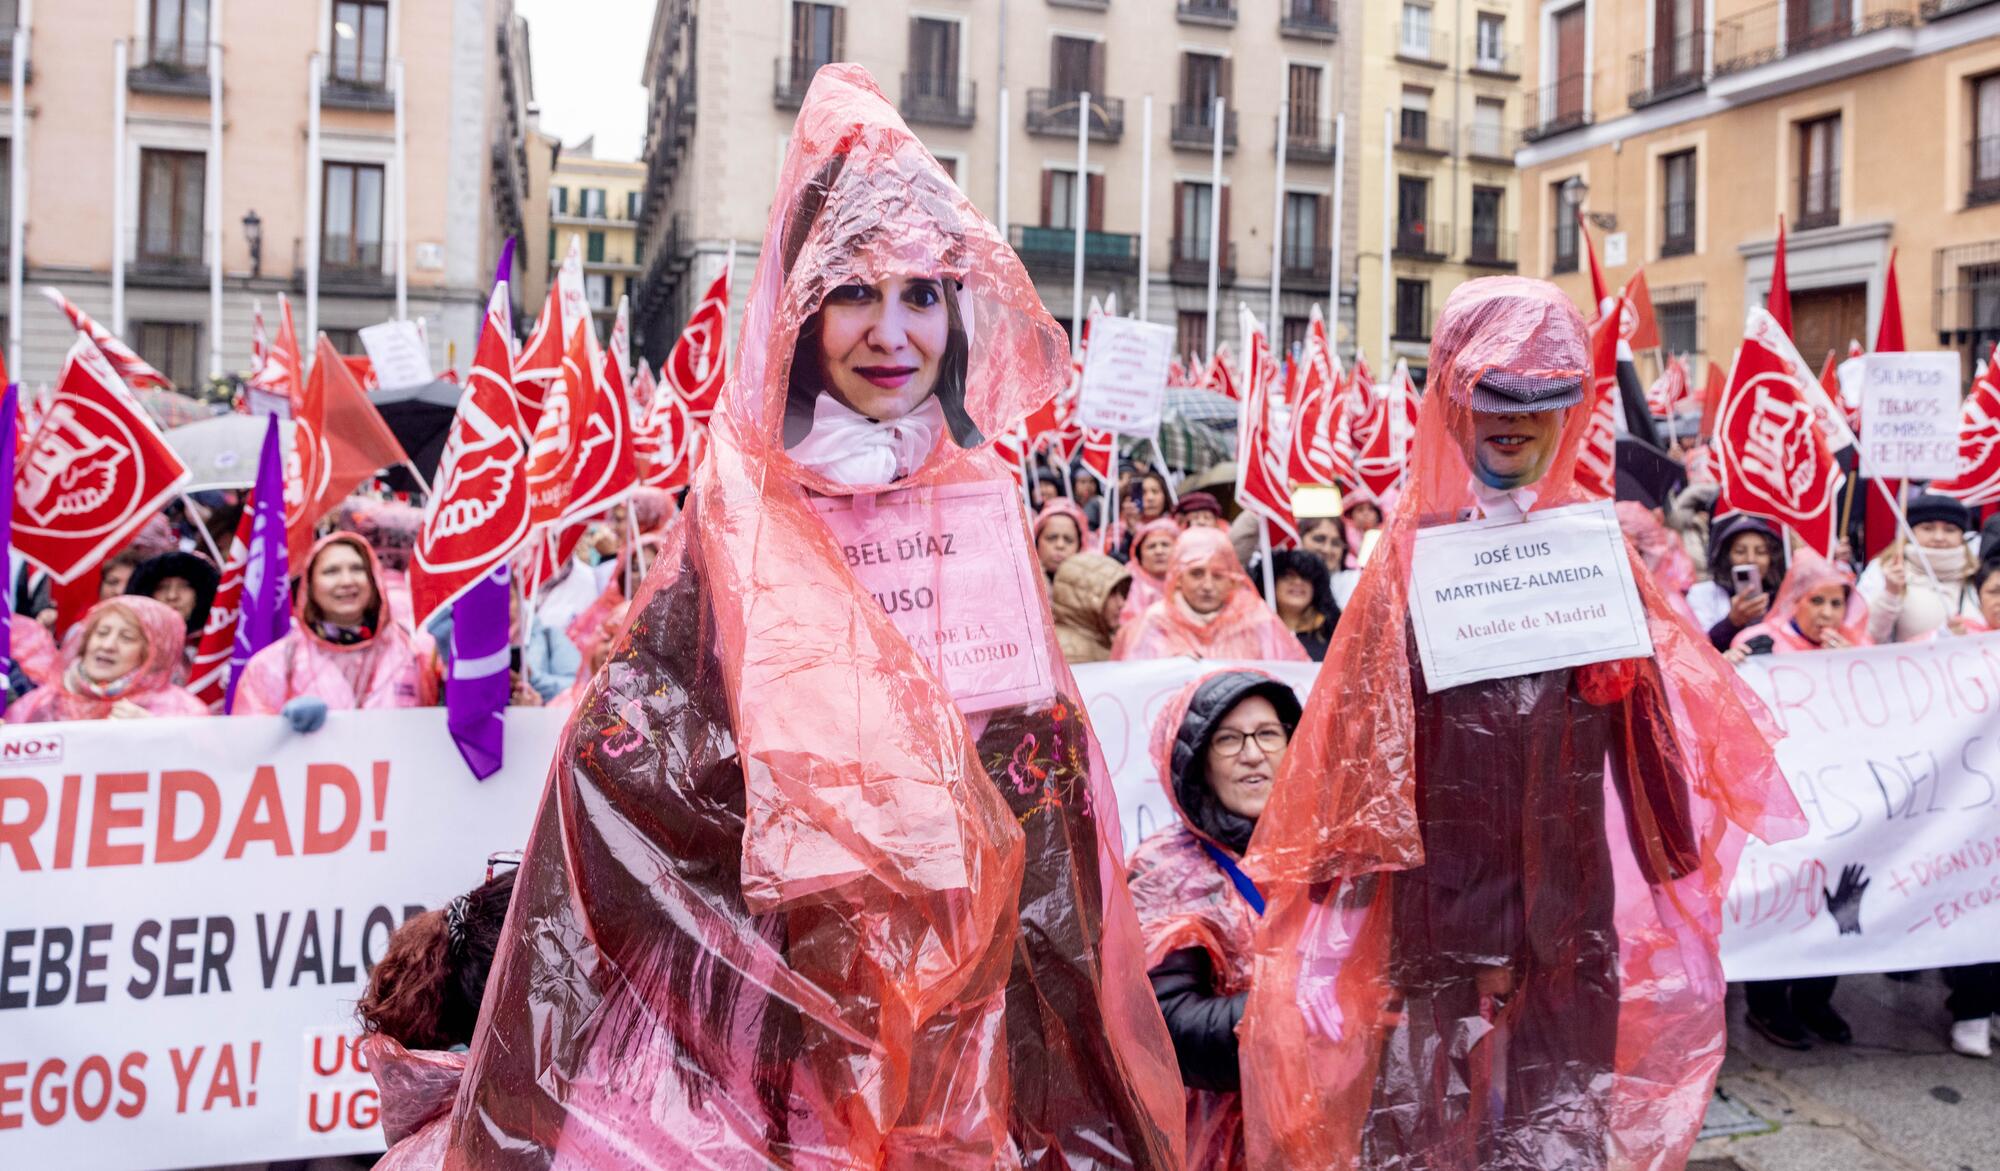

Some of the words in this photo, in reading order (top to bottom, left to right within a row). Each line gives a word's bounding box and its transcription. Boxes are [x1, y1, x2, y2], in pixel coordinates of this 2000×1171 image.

[896, 531, 957, 562] DÍAZ
[1474, 545, 1512, 567] JOSÉ
[1516, 542, 1551, 560] LUIS
[871, 586, 934, 615] USO
[1435, 564, 1604, 604] MARTINEZ-ALMEIDA
[934, 627, 960, 646] DE
[965, 623, 992, 641] LA
[1455, 616, 1517, 641] Alcalde
[1521, 614, 1541, 630] de
[1545, 604, 1608, 624] Madrid
[943, 643, 1020, 668] MADRID
[1866, 750, 1948, 820] DEL
[1960, 736, 2000, 812] S
[0, 761, 391, 871] RIEDAD!
[0, 923, 113, 1011] EBE
[126, 915, 236, 1001] SER
[255, 905, 427, 990] VALO
[0, 1050, 148, 1131] EGOS
[168, 1040, 262, 1115] YA!
[308, 1088, 380, 1133] UG
